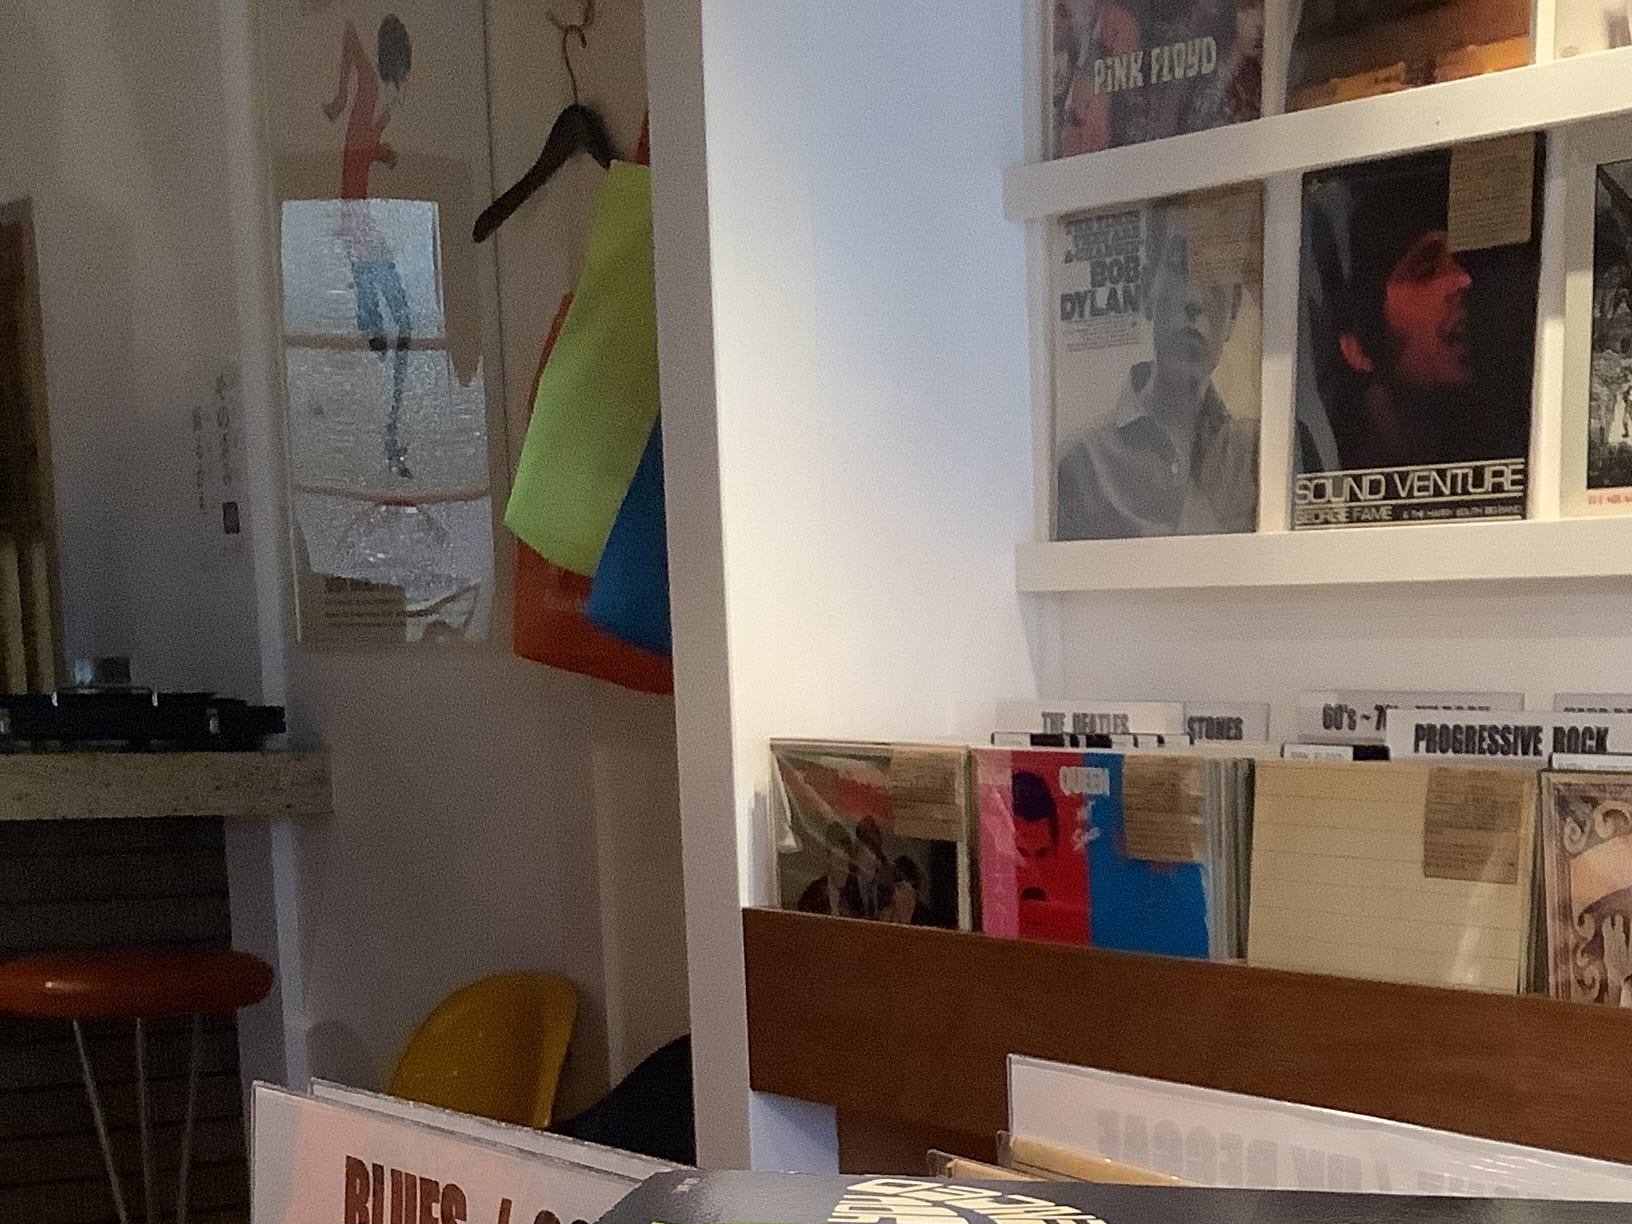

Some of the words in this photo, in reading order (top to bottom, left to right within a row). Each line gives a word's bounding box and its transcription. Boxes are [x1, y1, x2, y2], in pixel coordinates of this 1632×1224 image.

[1151, 36, 1216, 84] FLOYD
[1090, 254, 1140, 288] BOB
[1060, 285, 1141, 321] DYLAN
[1296, 474, 1386, 504] SOUND
[1394, 463, 1524, 497] VENTURE
[1353, 505, 1393, 521] FAME
[1041, 711, 1066, 734] THE
[1072, 711, 1130, 735] BEATLES
[1187, 715, 1244, 740] STONES
[1413, 723, 1543, 757] PROGRESSIVE
[1553, 726, 1610, 753] ROCK
